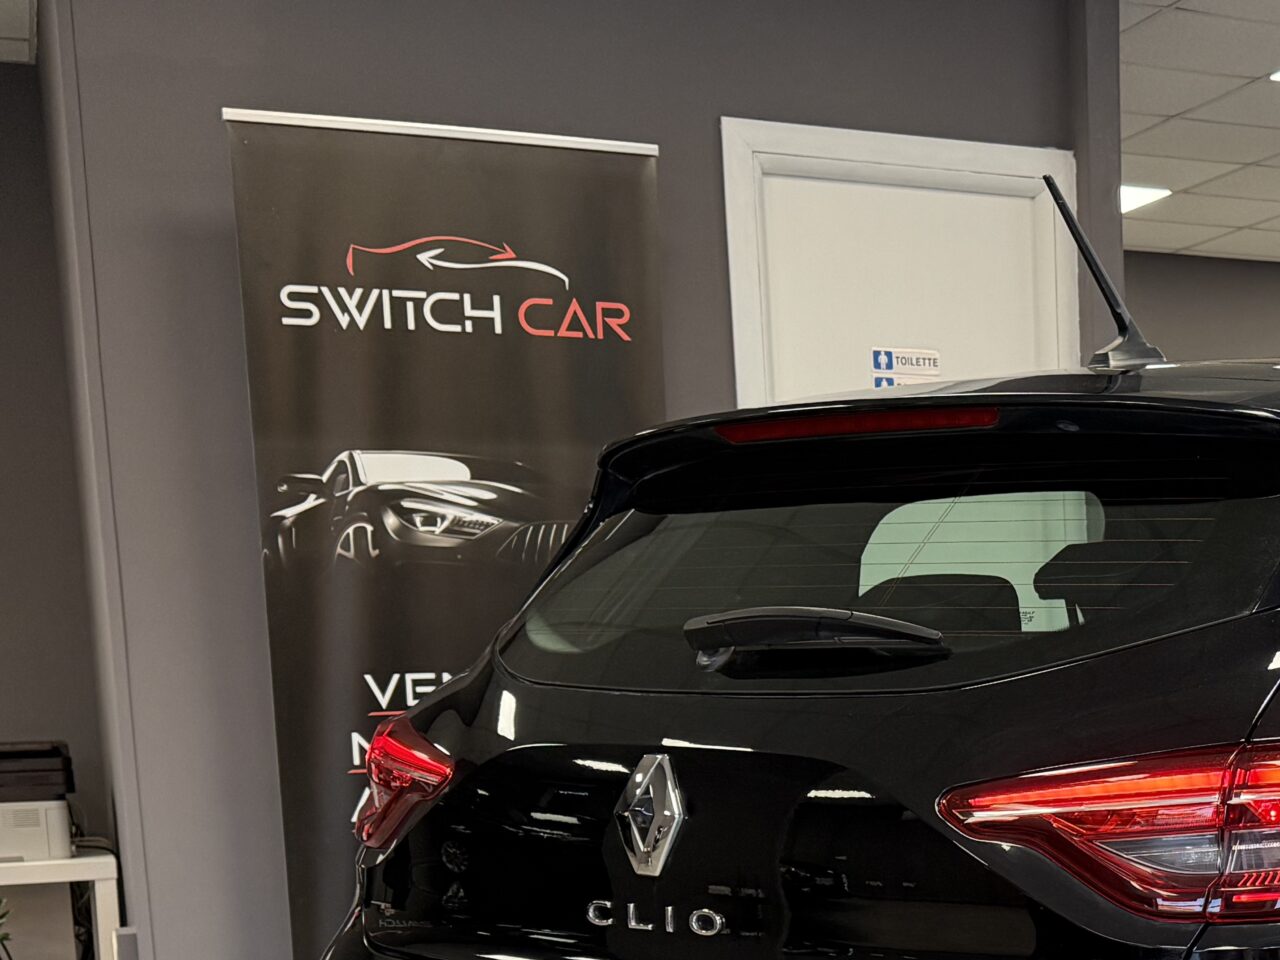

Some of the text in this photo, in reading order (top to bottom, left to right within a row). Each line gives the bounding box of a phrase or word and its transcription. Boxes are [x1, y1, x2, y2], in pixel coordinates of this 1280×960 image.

[279, 284, 632, 342] SWITCH CAR
[895, 356, 939, 368] TOILETTE
[363, 671, 453, 709] VE
[586, 900, 722, 936] CLIO
